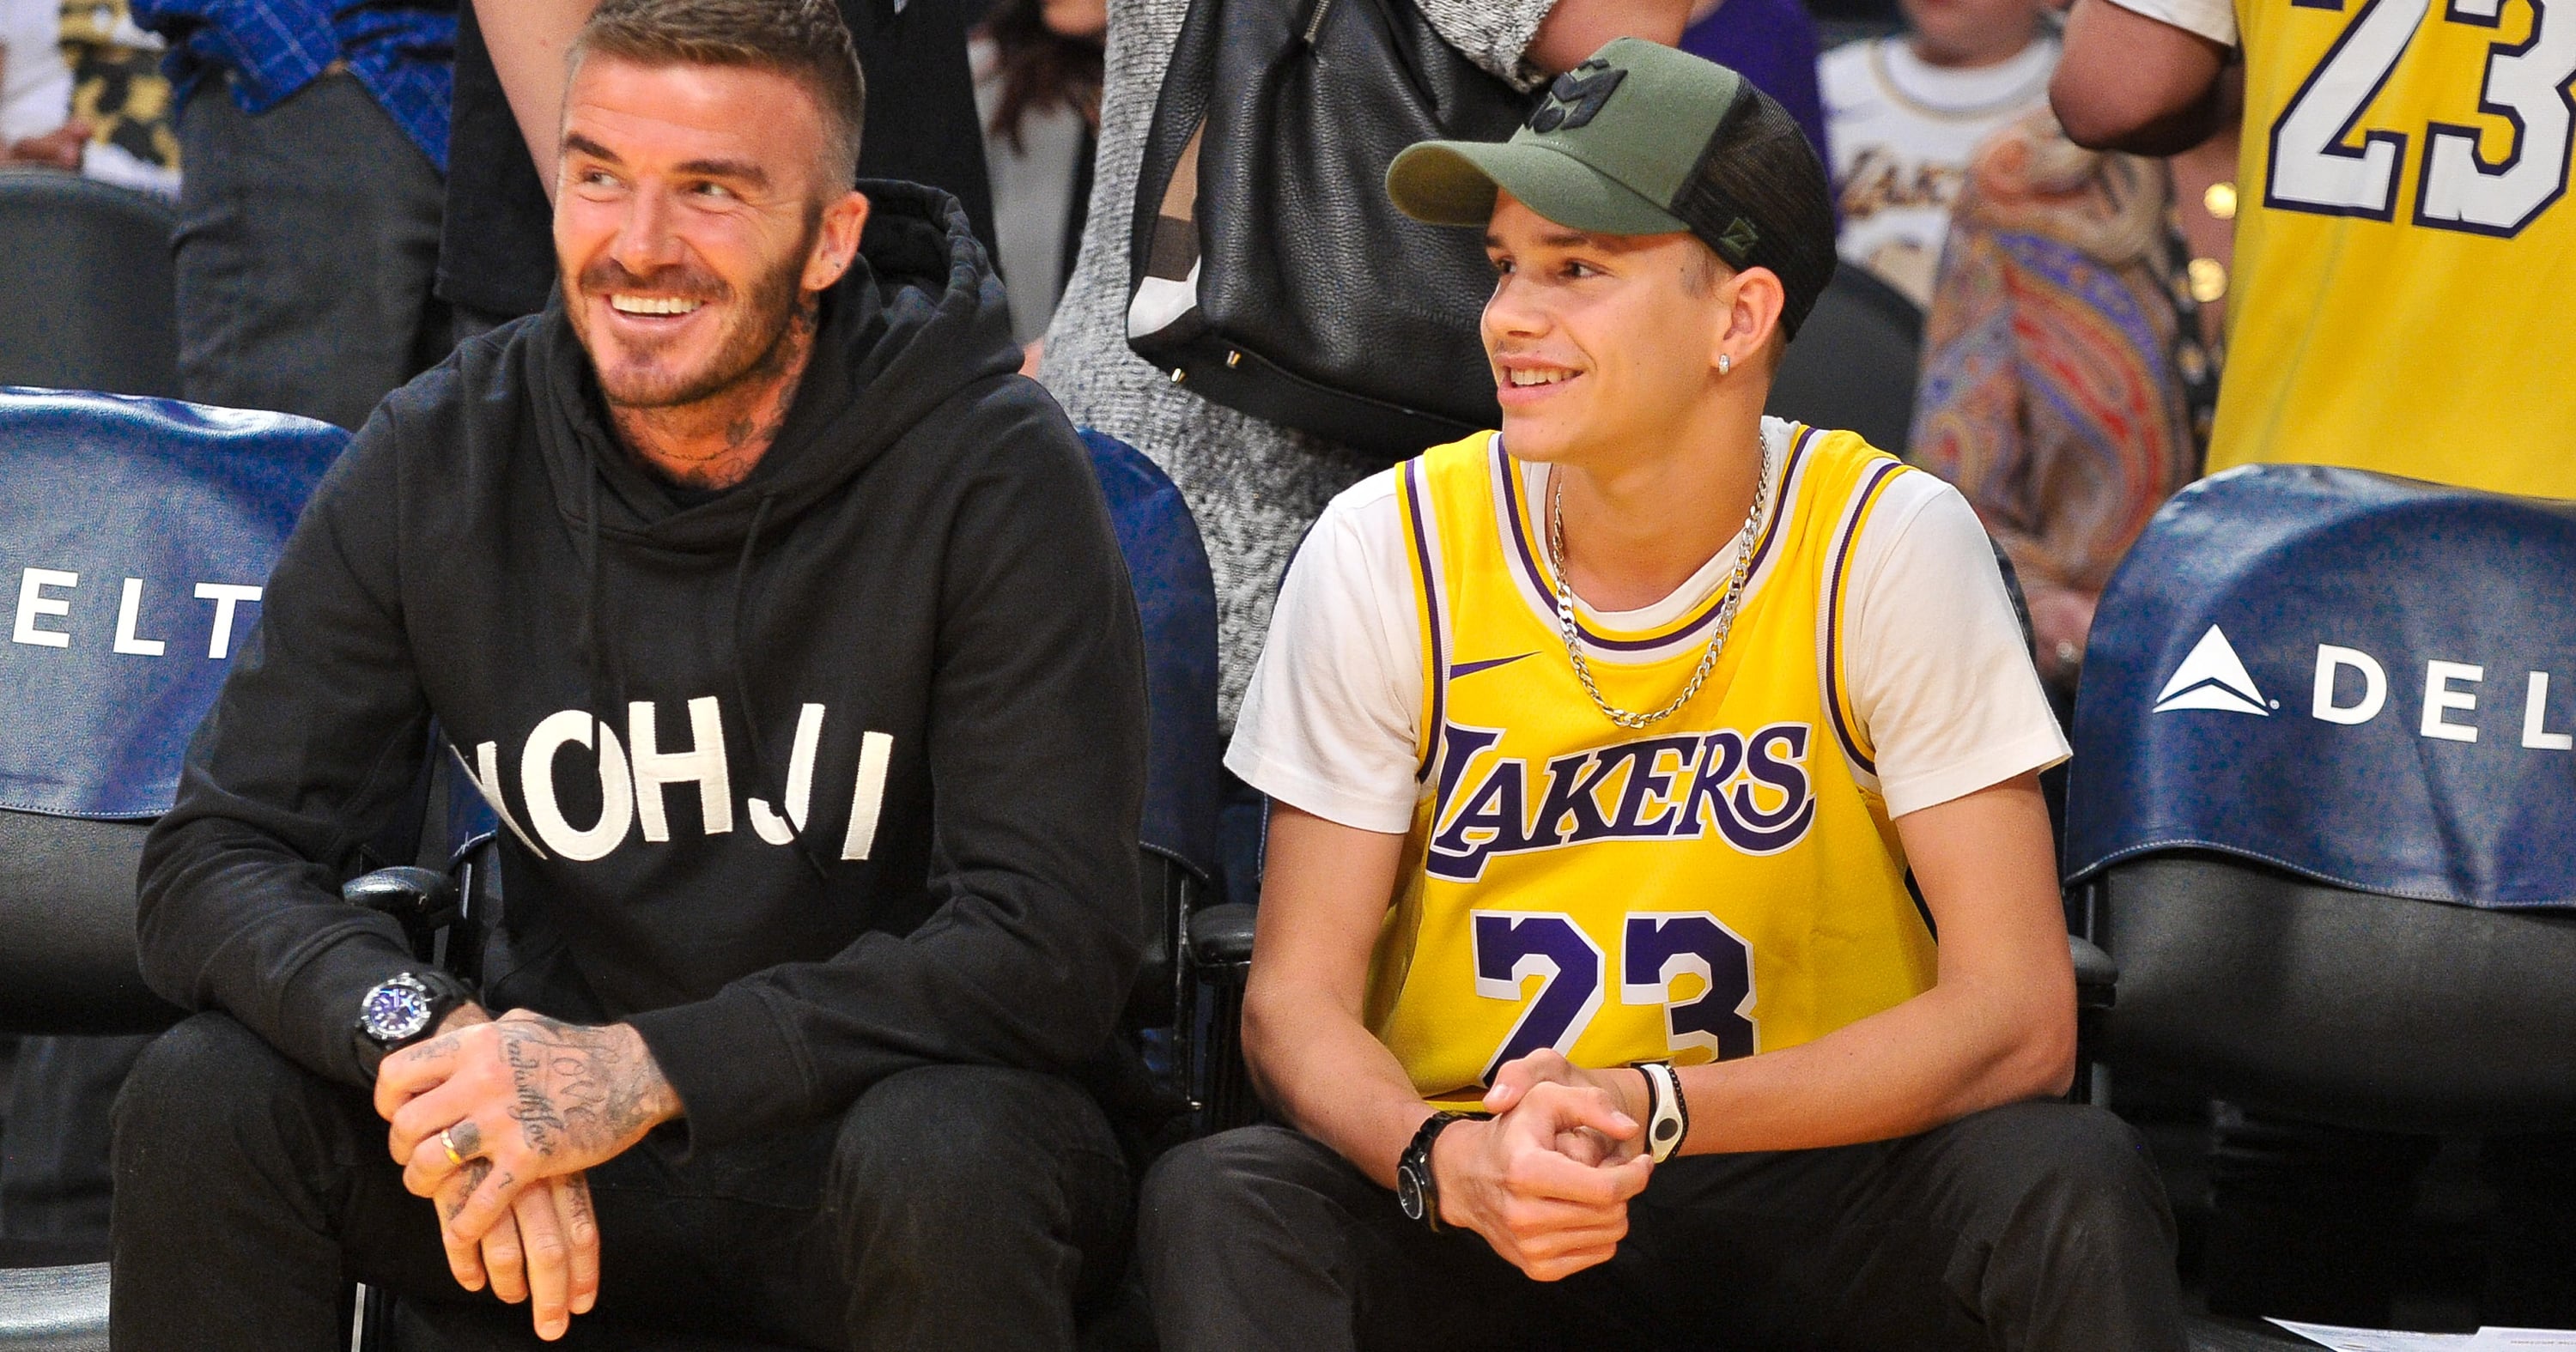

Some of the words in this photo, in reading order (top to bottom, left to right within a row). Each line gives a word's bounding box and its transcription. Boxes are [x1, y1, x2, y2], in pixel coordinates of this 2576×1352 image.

[2263, 0, 2576, 239] 23
[12, 567, 264, 659] ELT
[2312, 643, 2573, 751] DEL
[1425, 721, 1817, 884] LAKERS
[1469, 908, 1761, 1089] 23
